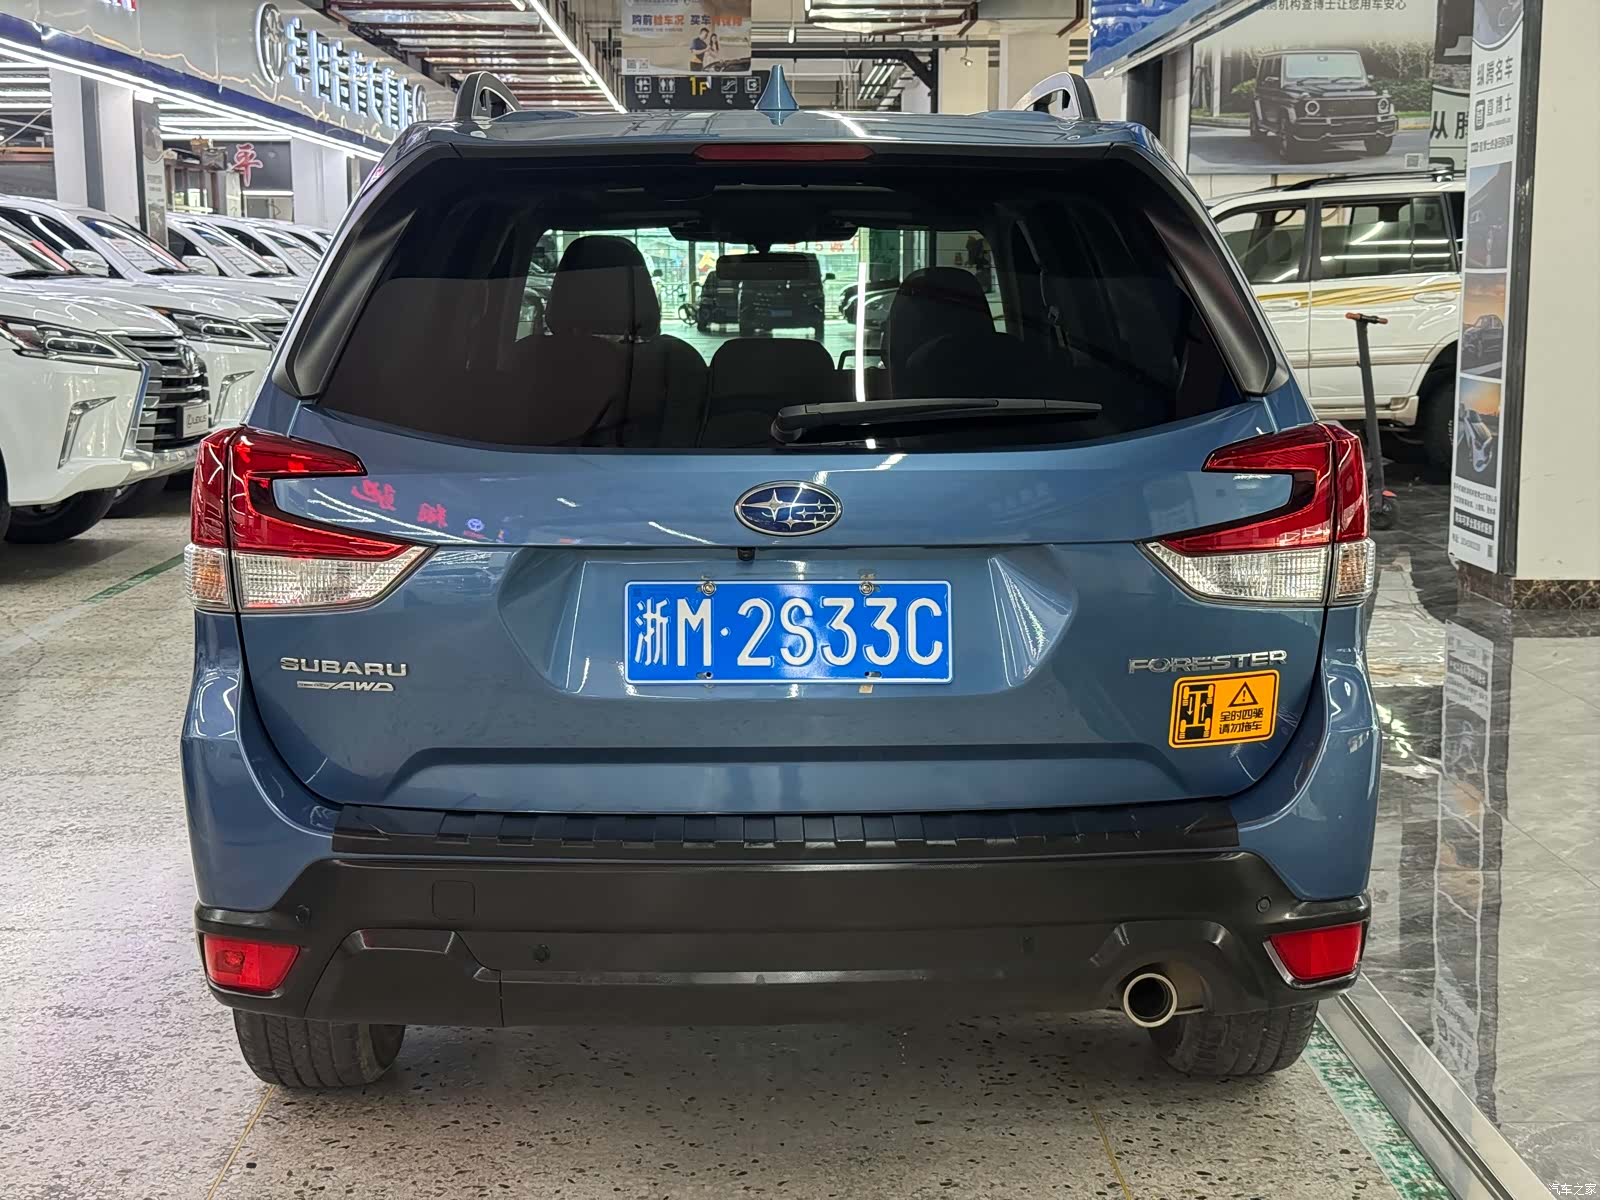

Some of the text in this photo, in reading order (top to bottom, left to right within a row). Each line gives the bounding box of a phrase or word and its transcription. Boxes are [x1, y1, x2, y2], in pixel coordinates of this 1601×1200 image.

[279, 656, 407, 677] SUBARU
[1128, 649, 1288, 675] FORESTER
[330, 681, 395, 692] AWD
[1219, 707, 1264, 722] 全时四驱
[1218, 720, 1263, 735] 请勿拖车
